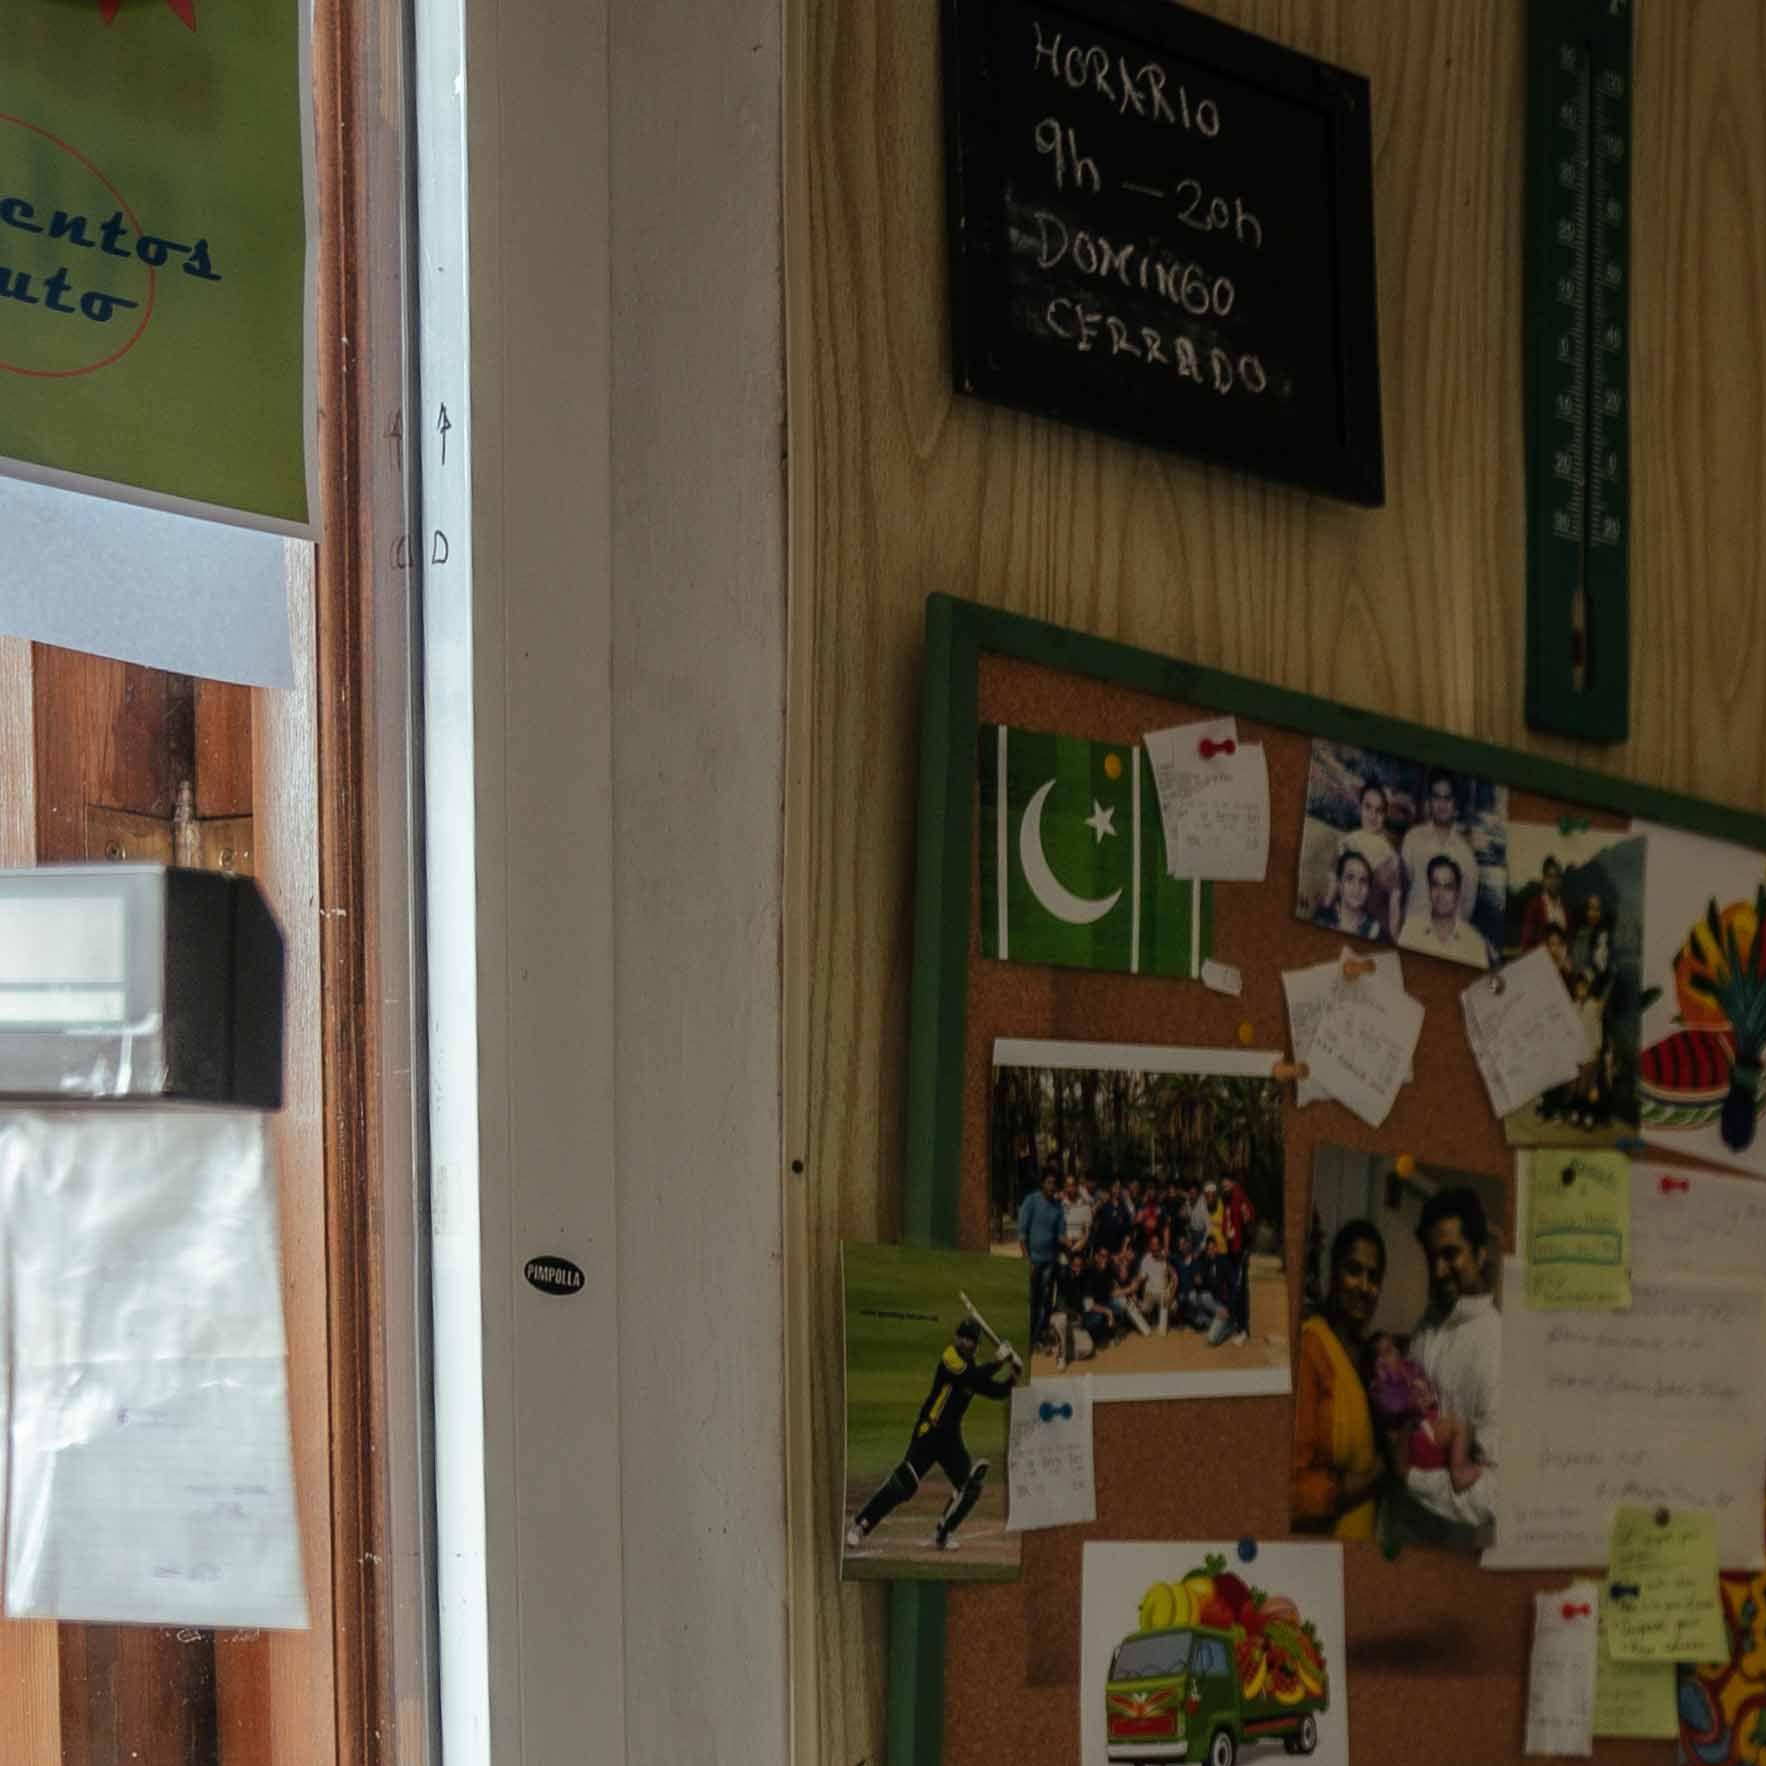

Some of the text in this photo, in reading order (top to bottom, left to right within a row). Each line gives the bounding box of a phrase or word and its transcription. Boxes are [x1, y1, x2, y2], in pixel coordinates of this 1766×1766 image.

[1030, 20, 1223, 141] HORARIO
[1031, 115, 1103, 195] 9h
[1034, 208, 1237, 319] DOMINGO
[1044, 295, 1269, 396] CERRADO
[527, 1263, 581, 1288] PIMPOLLA
